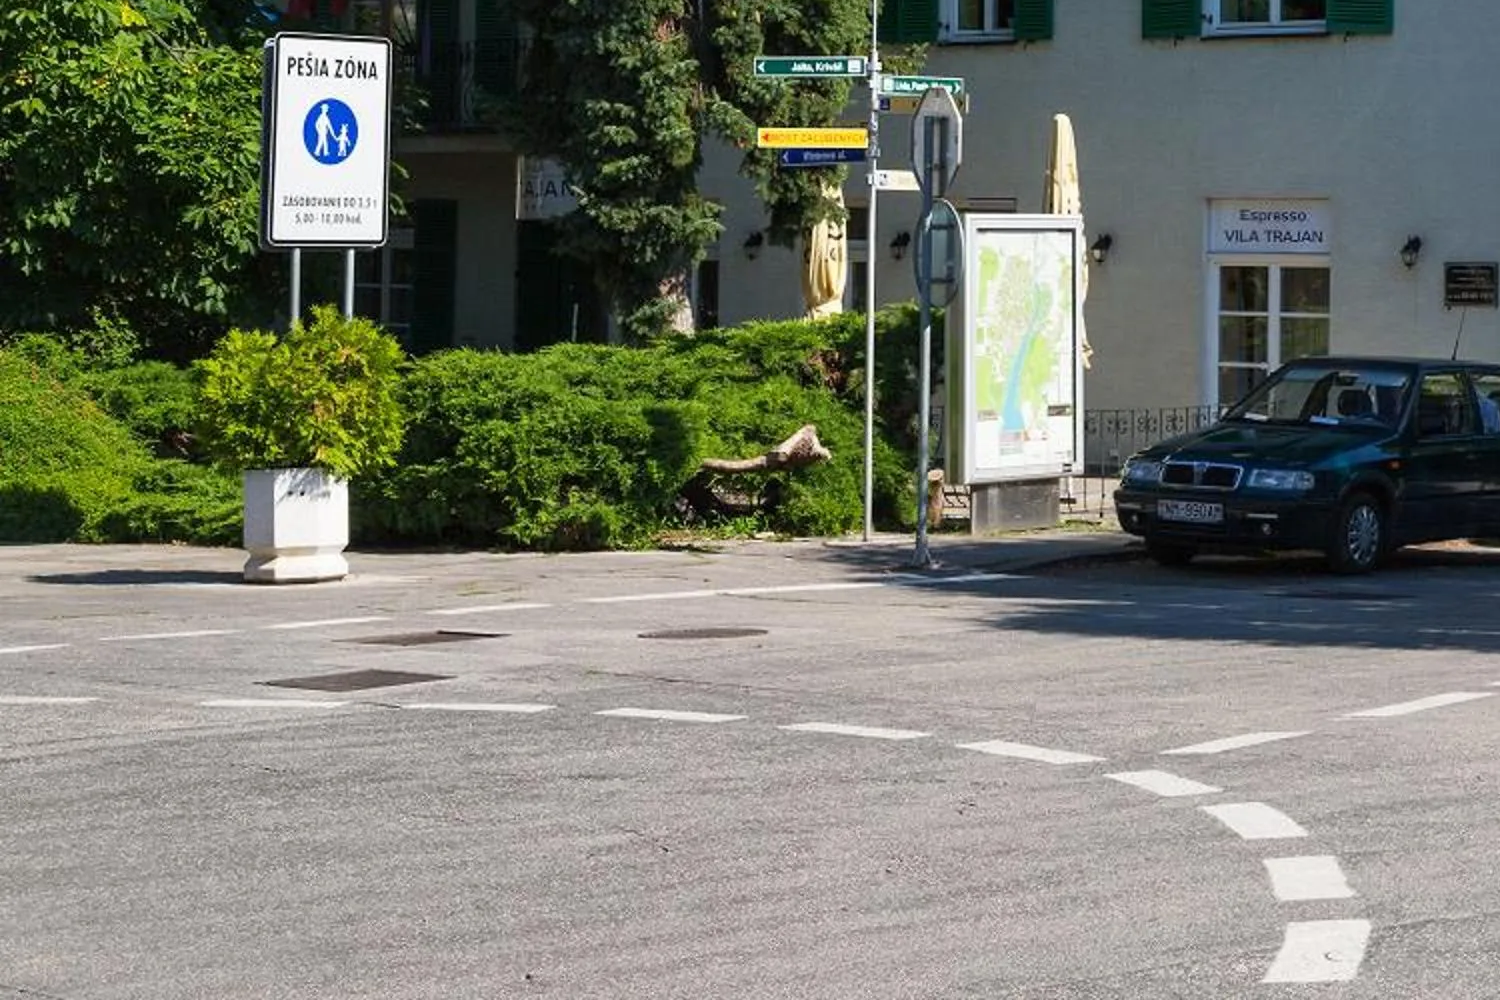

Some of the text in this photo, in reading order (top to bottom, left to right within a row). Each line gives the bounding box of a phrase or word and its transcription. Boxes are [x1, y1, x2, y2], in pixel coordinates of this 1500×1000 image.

[287, 51, 378, 80] PEŠIA ZÓNA
[1239, 209, 1307, 223] Espresso
[1224, 229, 1323, 244] VILA TRAJAN
